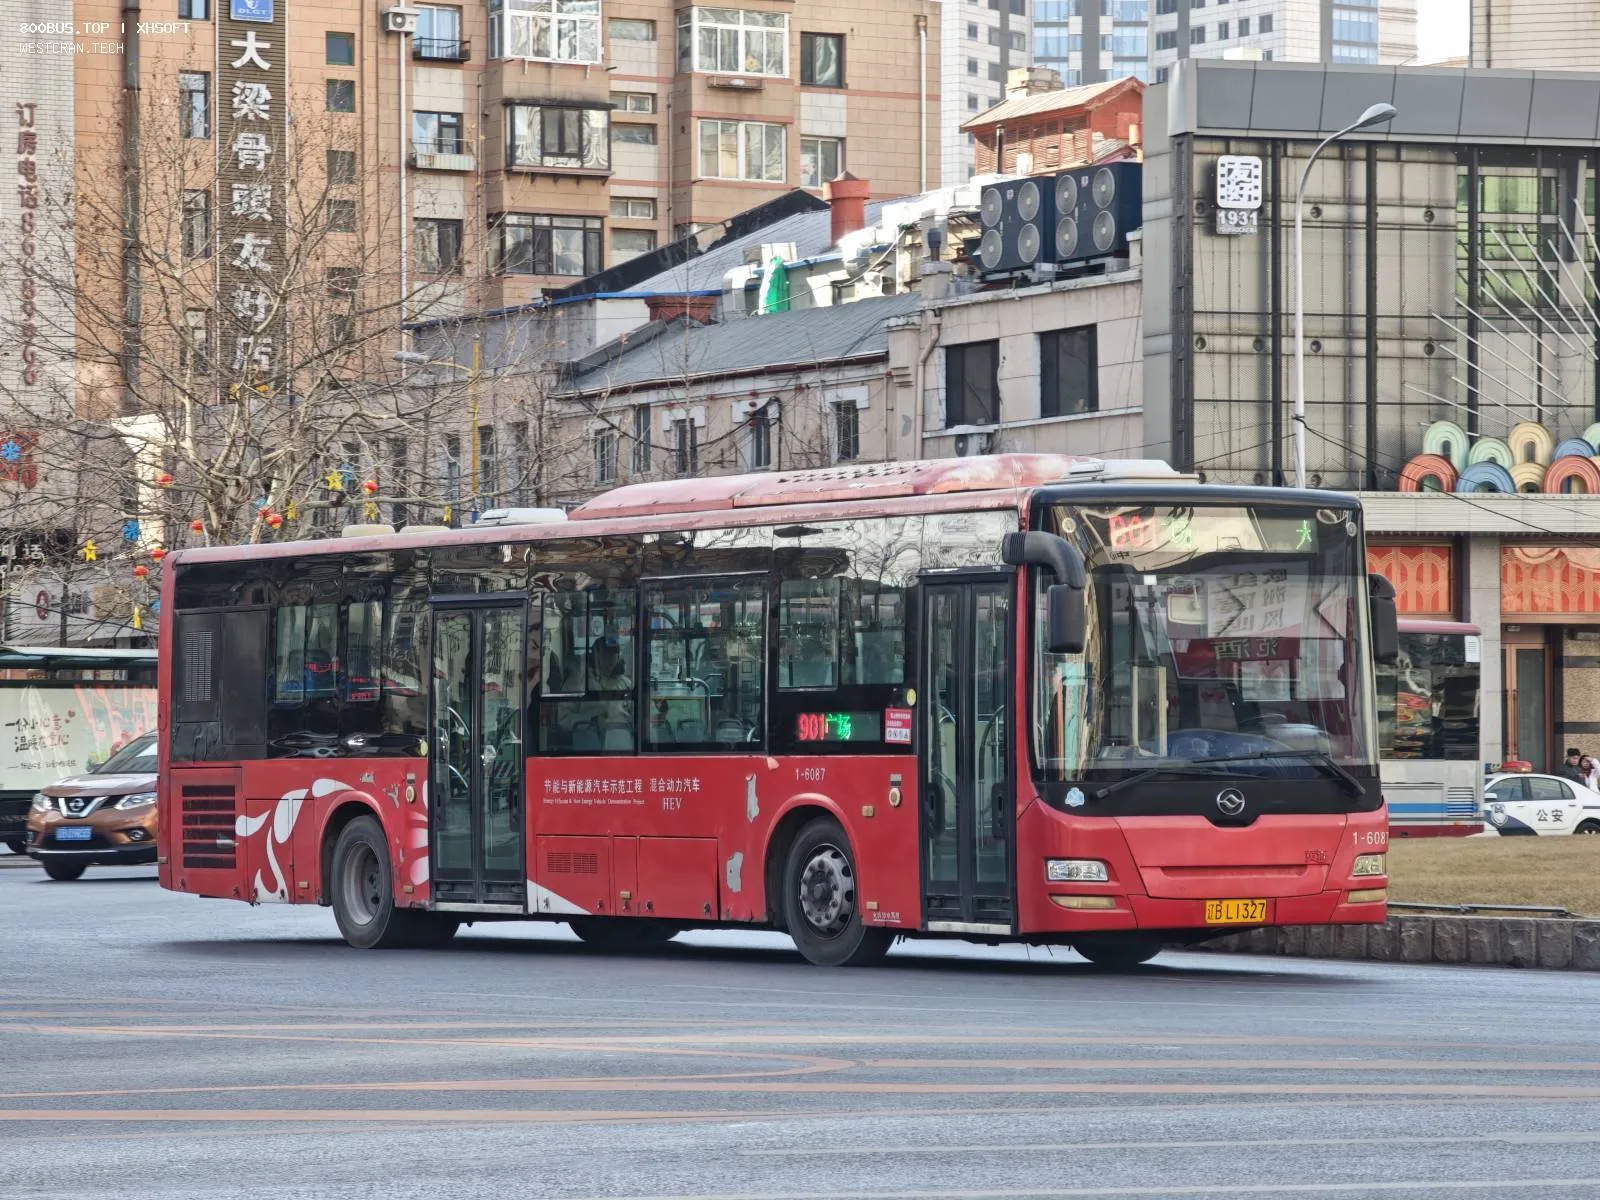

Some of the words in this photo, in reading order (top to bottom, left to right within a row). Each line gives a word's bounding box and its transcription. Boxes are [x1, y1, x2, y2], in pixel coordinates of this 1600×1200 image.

[1219, 210, 1258, 226] 1931
[798, 713, 825, 741] 901
[825, 713, 852, 740] 广场
[795, 767, 826, 782] 1-6087
[544, 778, 643, 794] 节能与新能源汽车示范工程
[650, 777, 701, 793] 混合动力汽车
[662, 797, 682, 811] HEV
[1536, 809, 1563, 822] 公安
